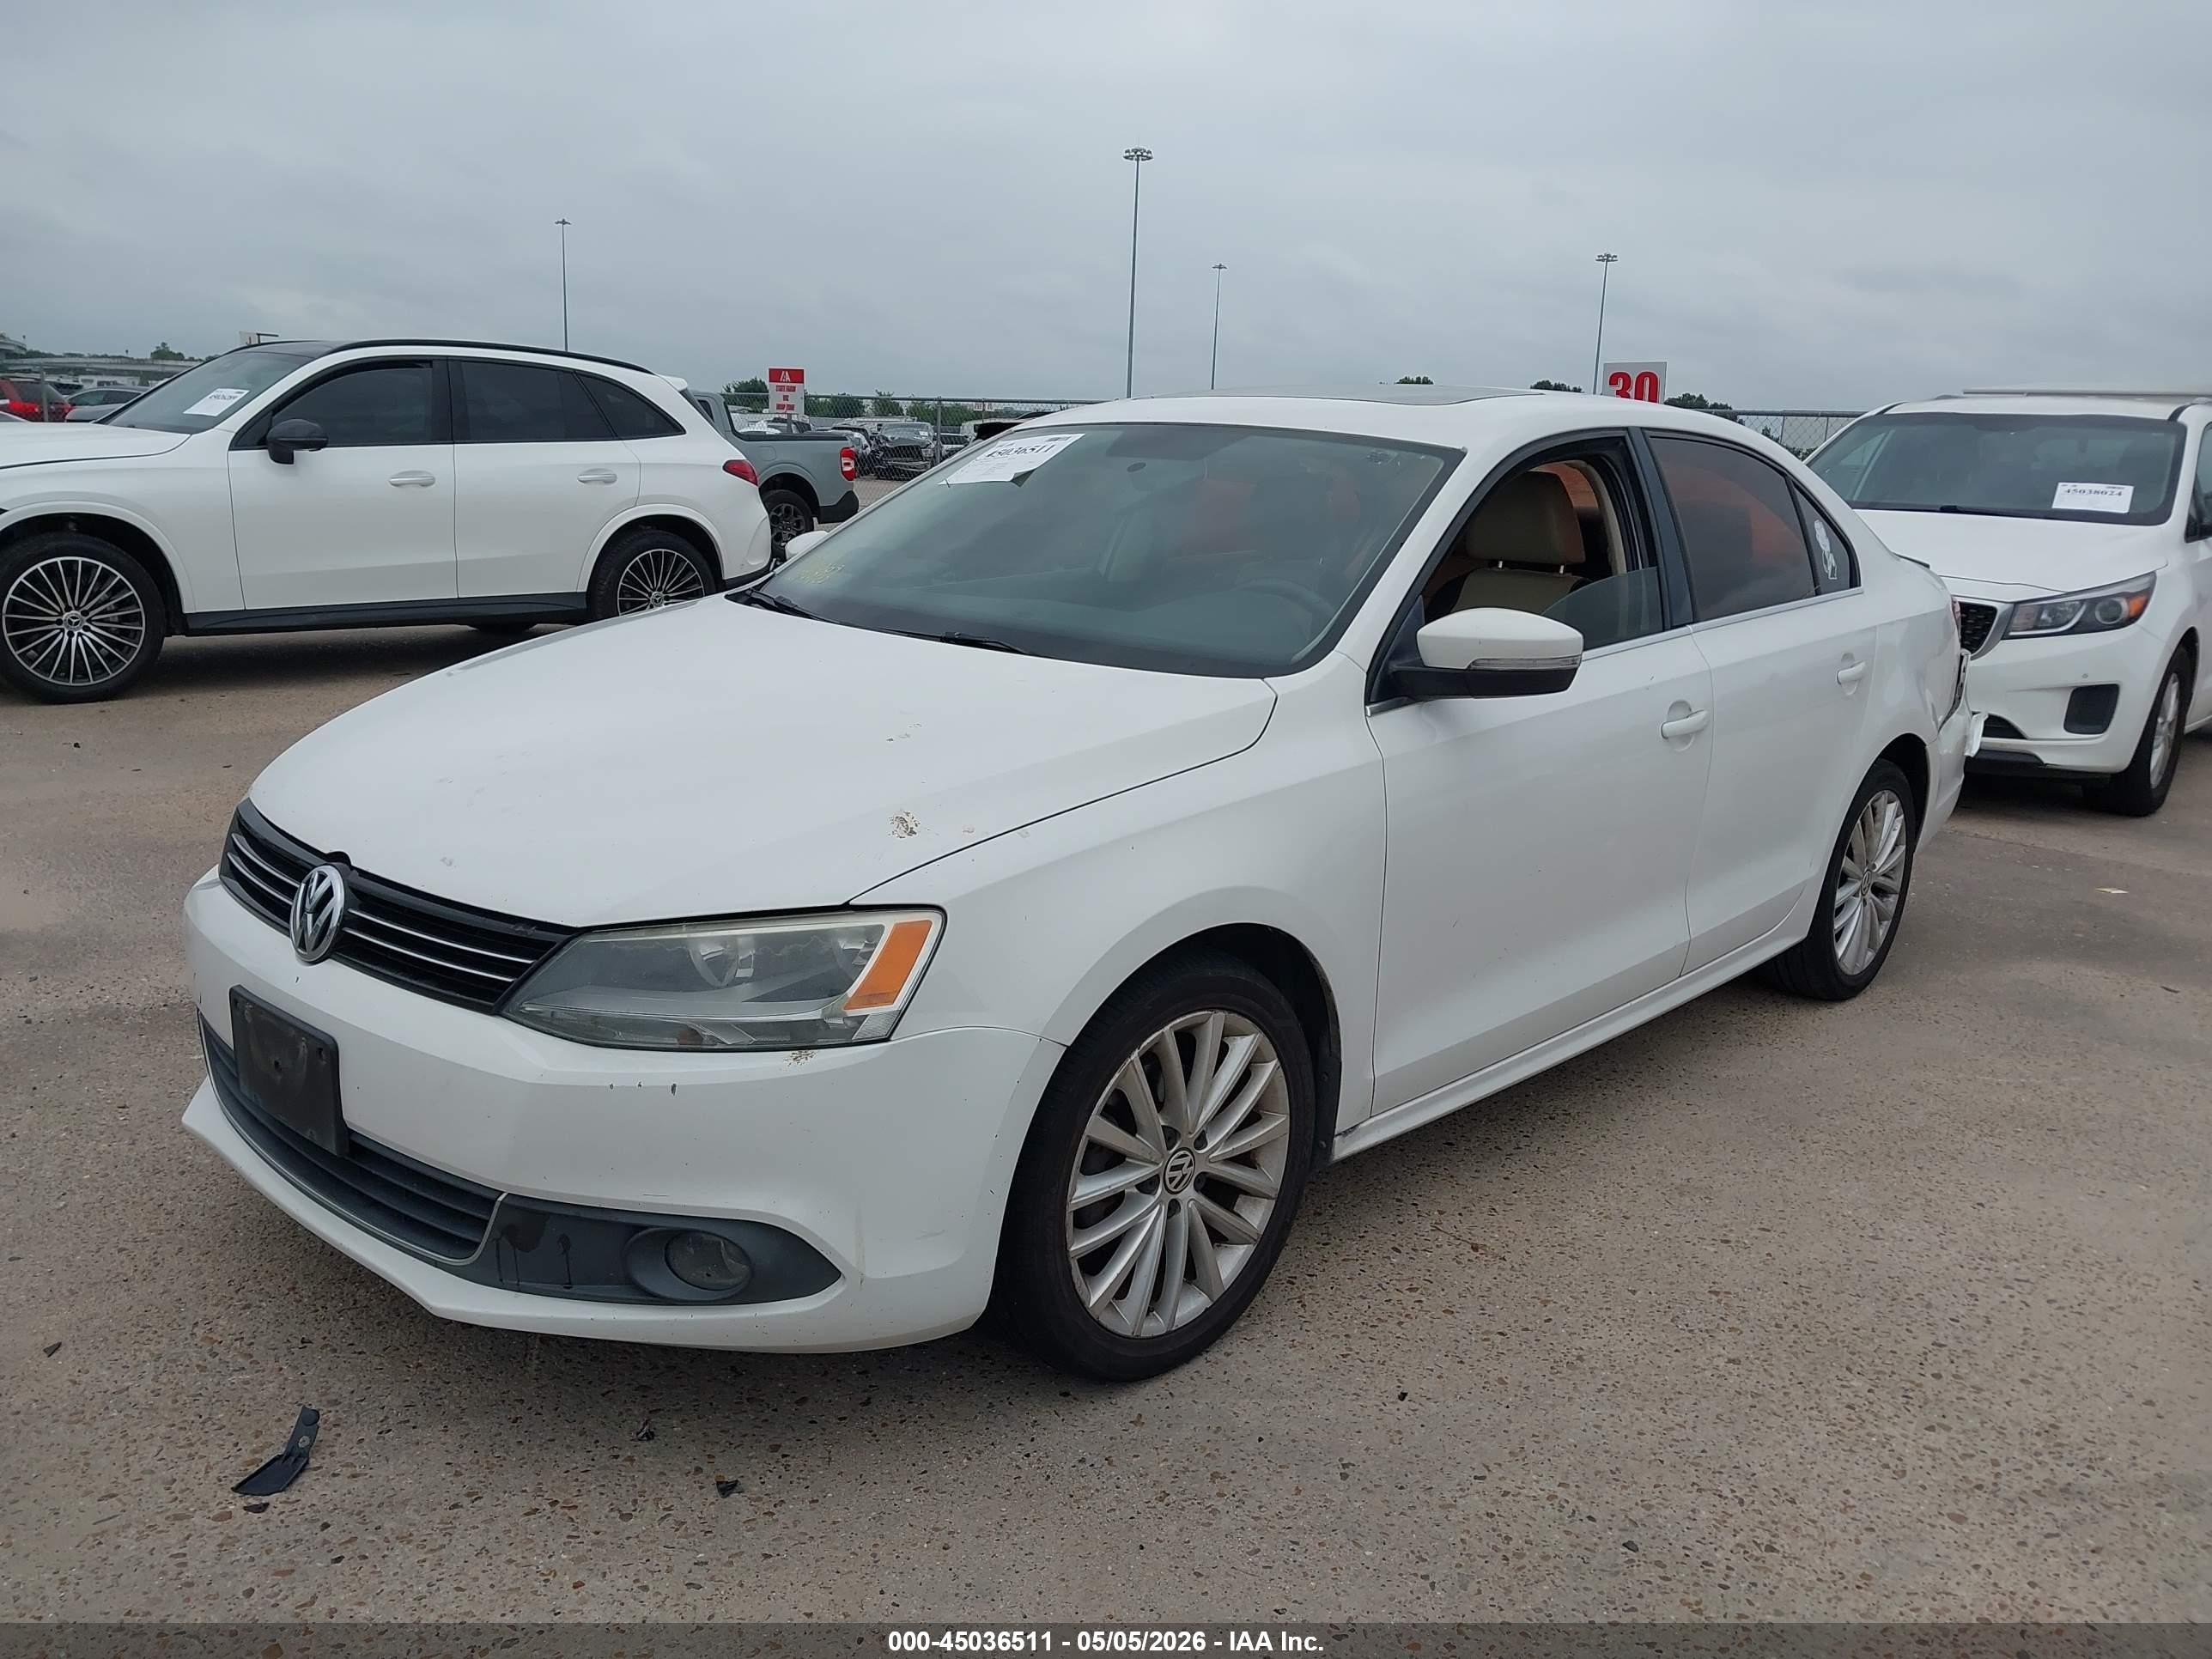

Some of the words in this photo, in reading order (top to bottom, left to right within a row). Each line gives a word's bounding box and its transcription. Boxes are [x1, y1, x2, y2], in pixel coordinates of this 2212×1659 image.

[1608, 371, 1659, 403] 30
[986, 444, 1057, 459] 45036511
[290, 865, 344, 962] VW
